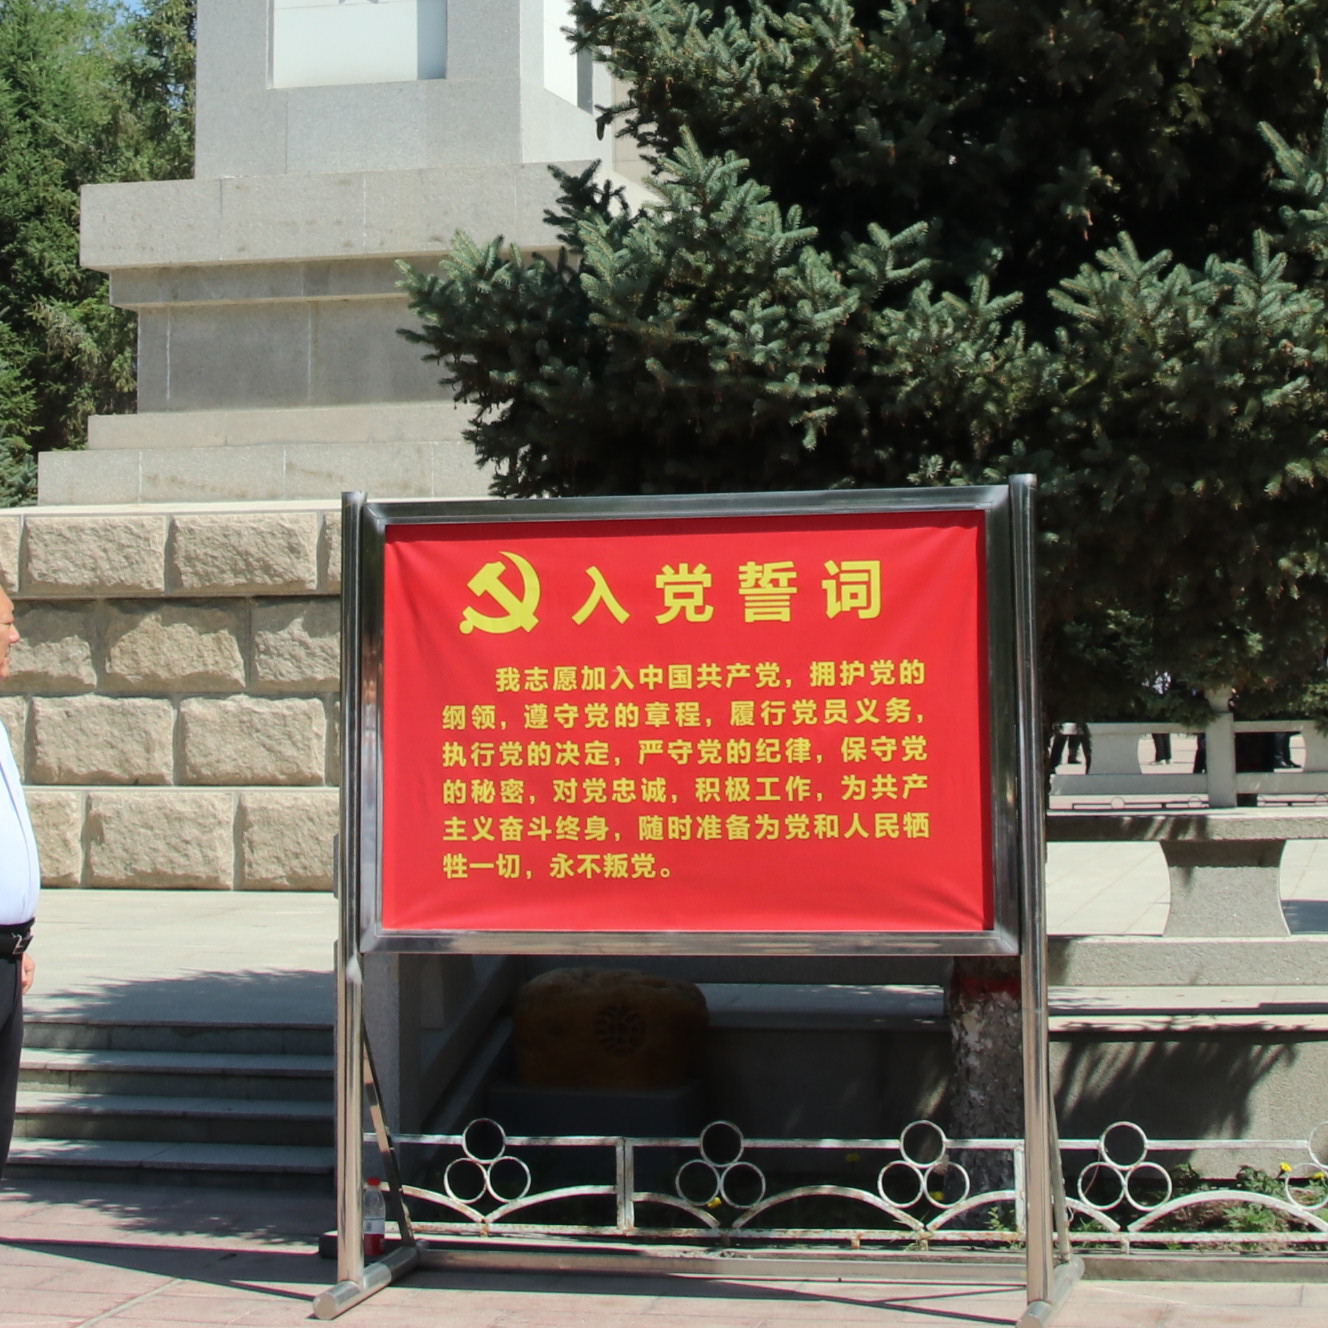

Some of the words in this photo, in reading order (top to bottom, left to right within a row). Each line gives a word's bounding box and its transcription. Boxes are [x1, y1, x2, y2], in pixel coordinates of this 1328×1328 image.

[572, 560, 882, 625] 入党誓词
[495, 659, 926, 693] 我志愿加入中国共产党，拥护党的
[441, 697, 925, 730] 纲领，遵守党的章程，履行党员义务，
[441, 735, 928, 768] 执行党的决定，严守党的纪律，保守党
[442, 773, 929, 805] 的秘密，对党忠诚，积极工作，为共产
[442, 811, 930, 842] 主义奋斗终身，随时准备为党和人民牺
[442, 852, 672, 879] 牲一切，永不叛党。
